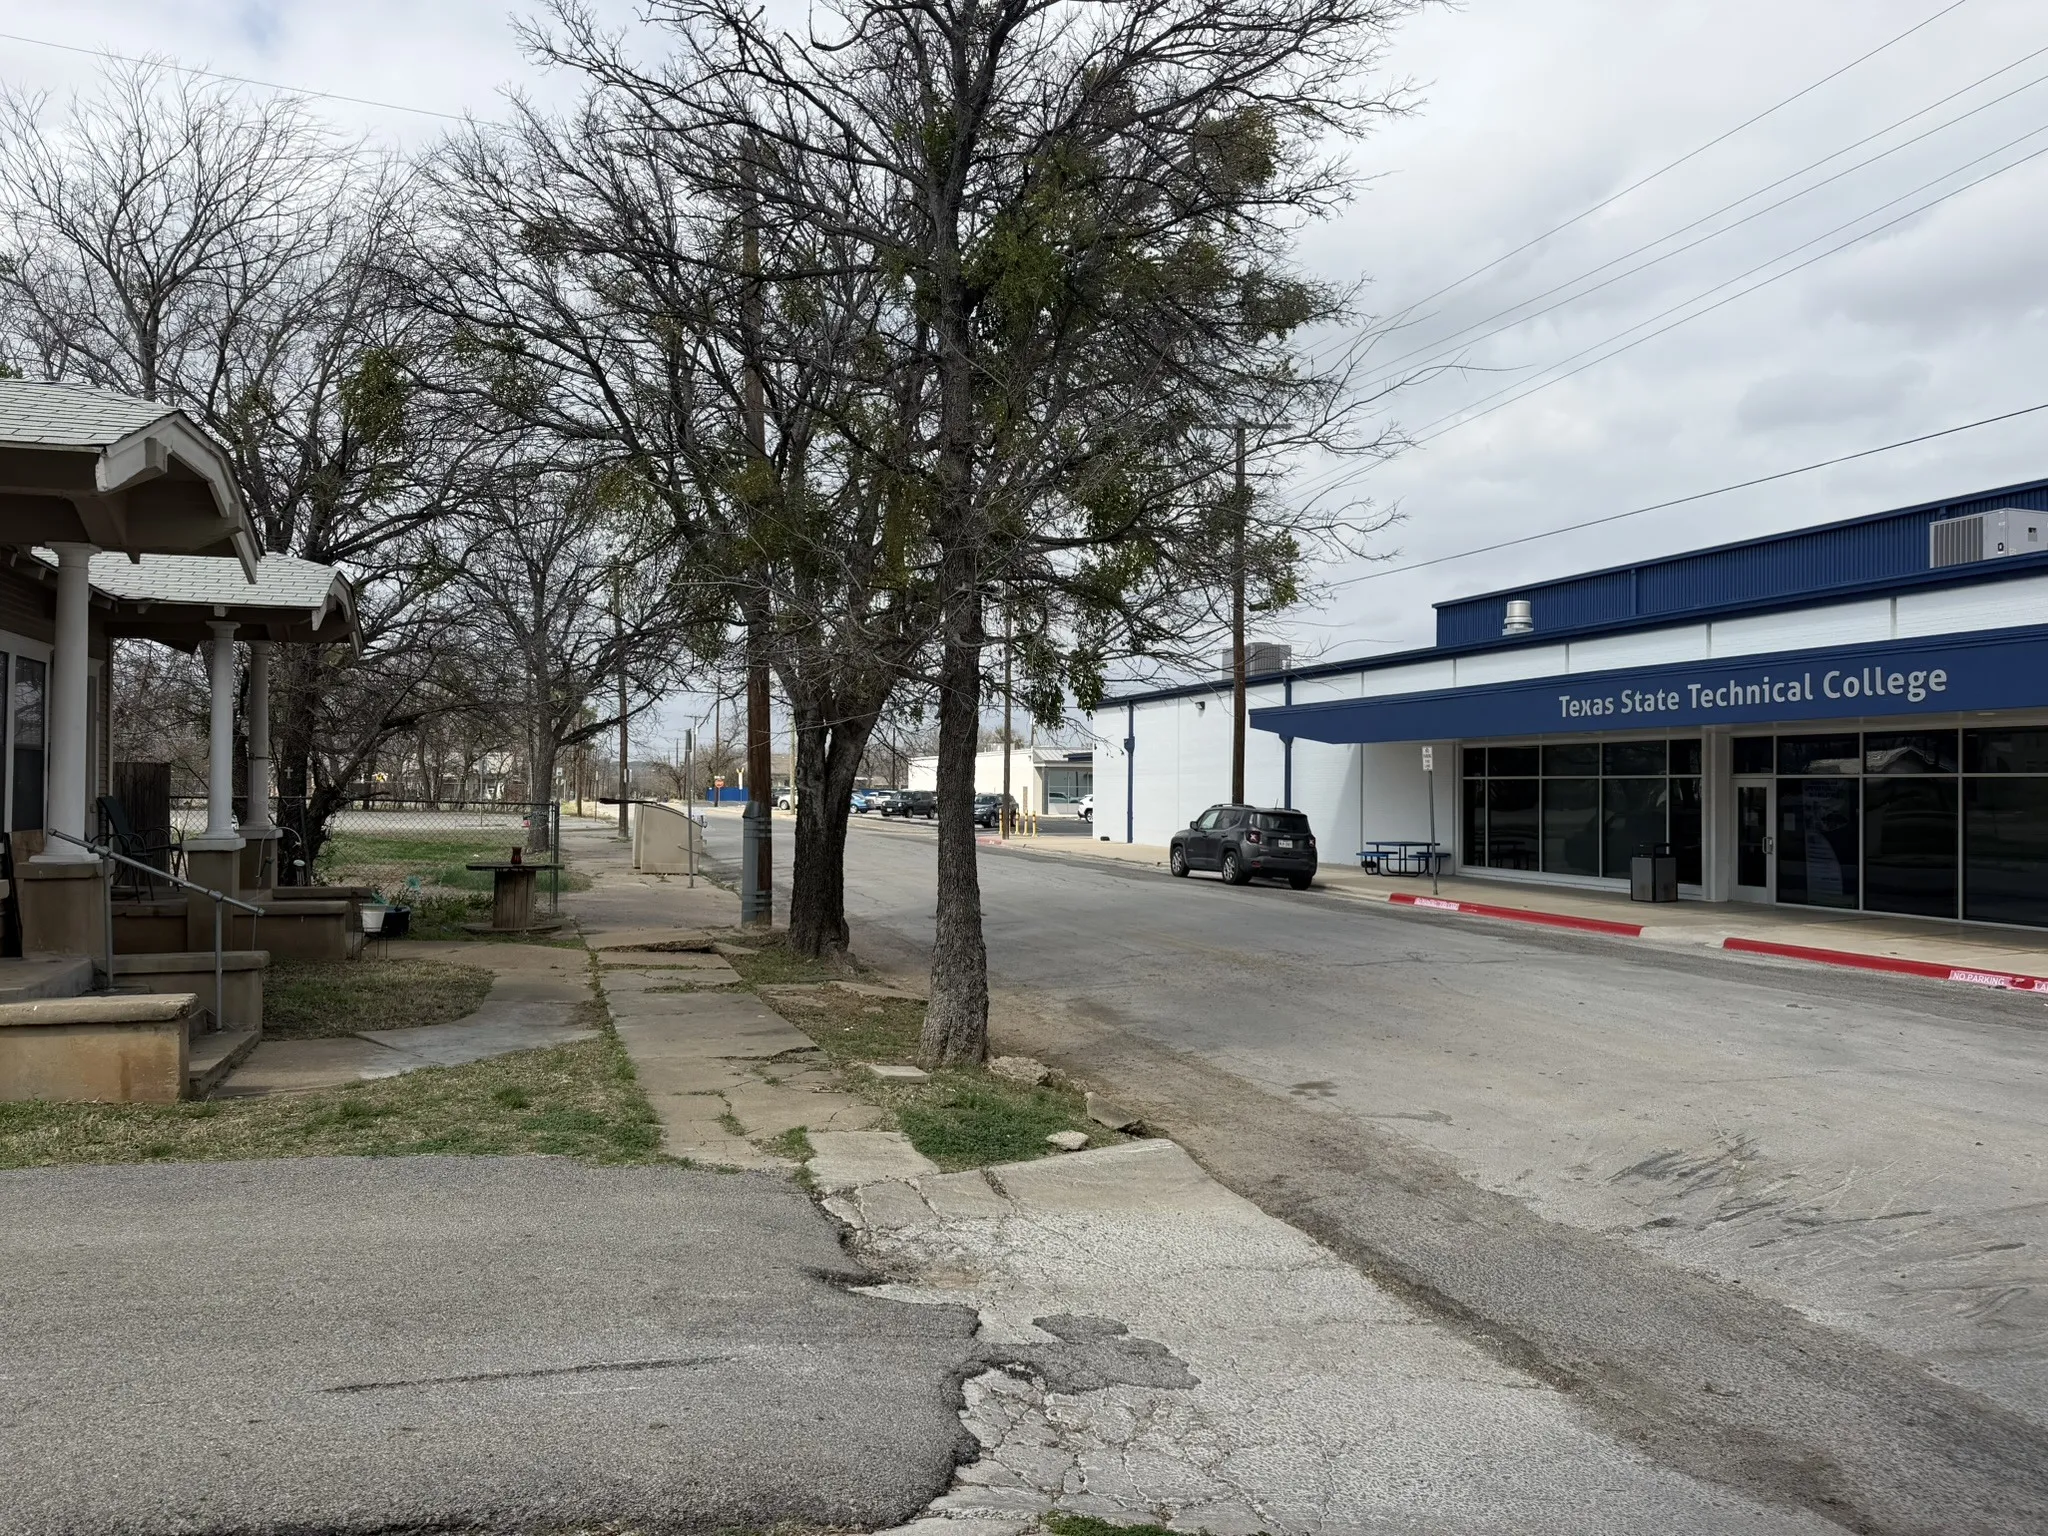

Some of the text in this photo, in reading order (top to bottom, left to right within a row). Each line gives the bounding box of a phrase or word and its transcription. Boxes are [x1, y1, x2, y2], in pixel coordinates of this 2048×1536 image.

[1559, 666, 1947, 718] Texas State Technical College
[1952, 972, 1966, 981] NO
[1967, 974, 2005, 986] PARKING
